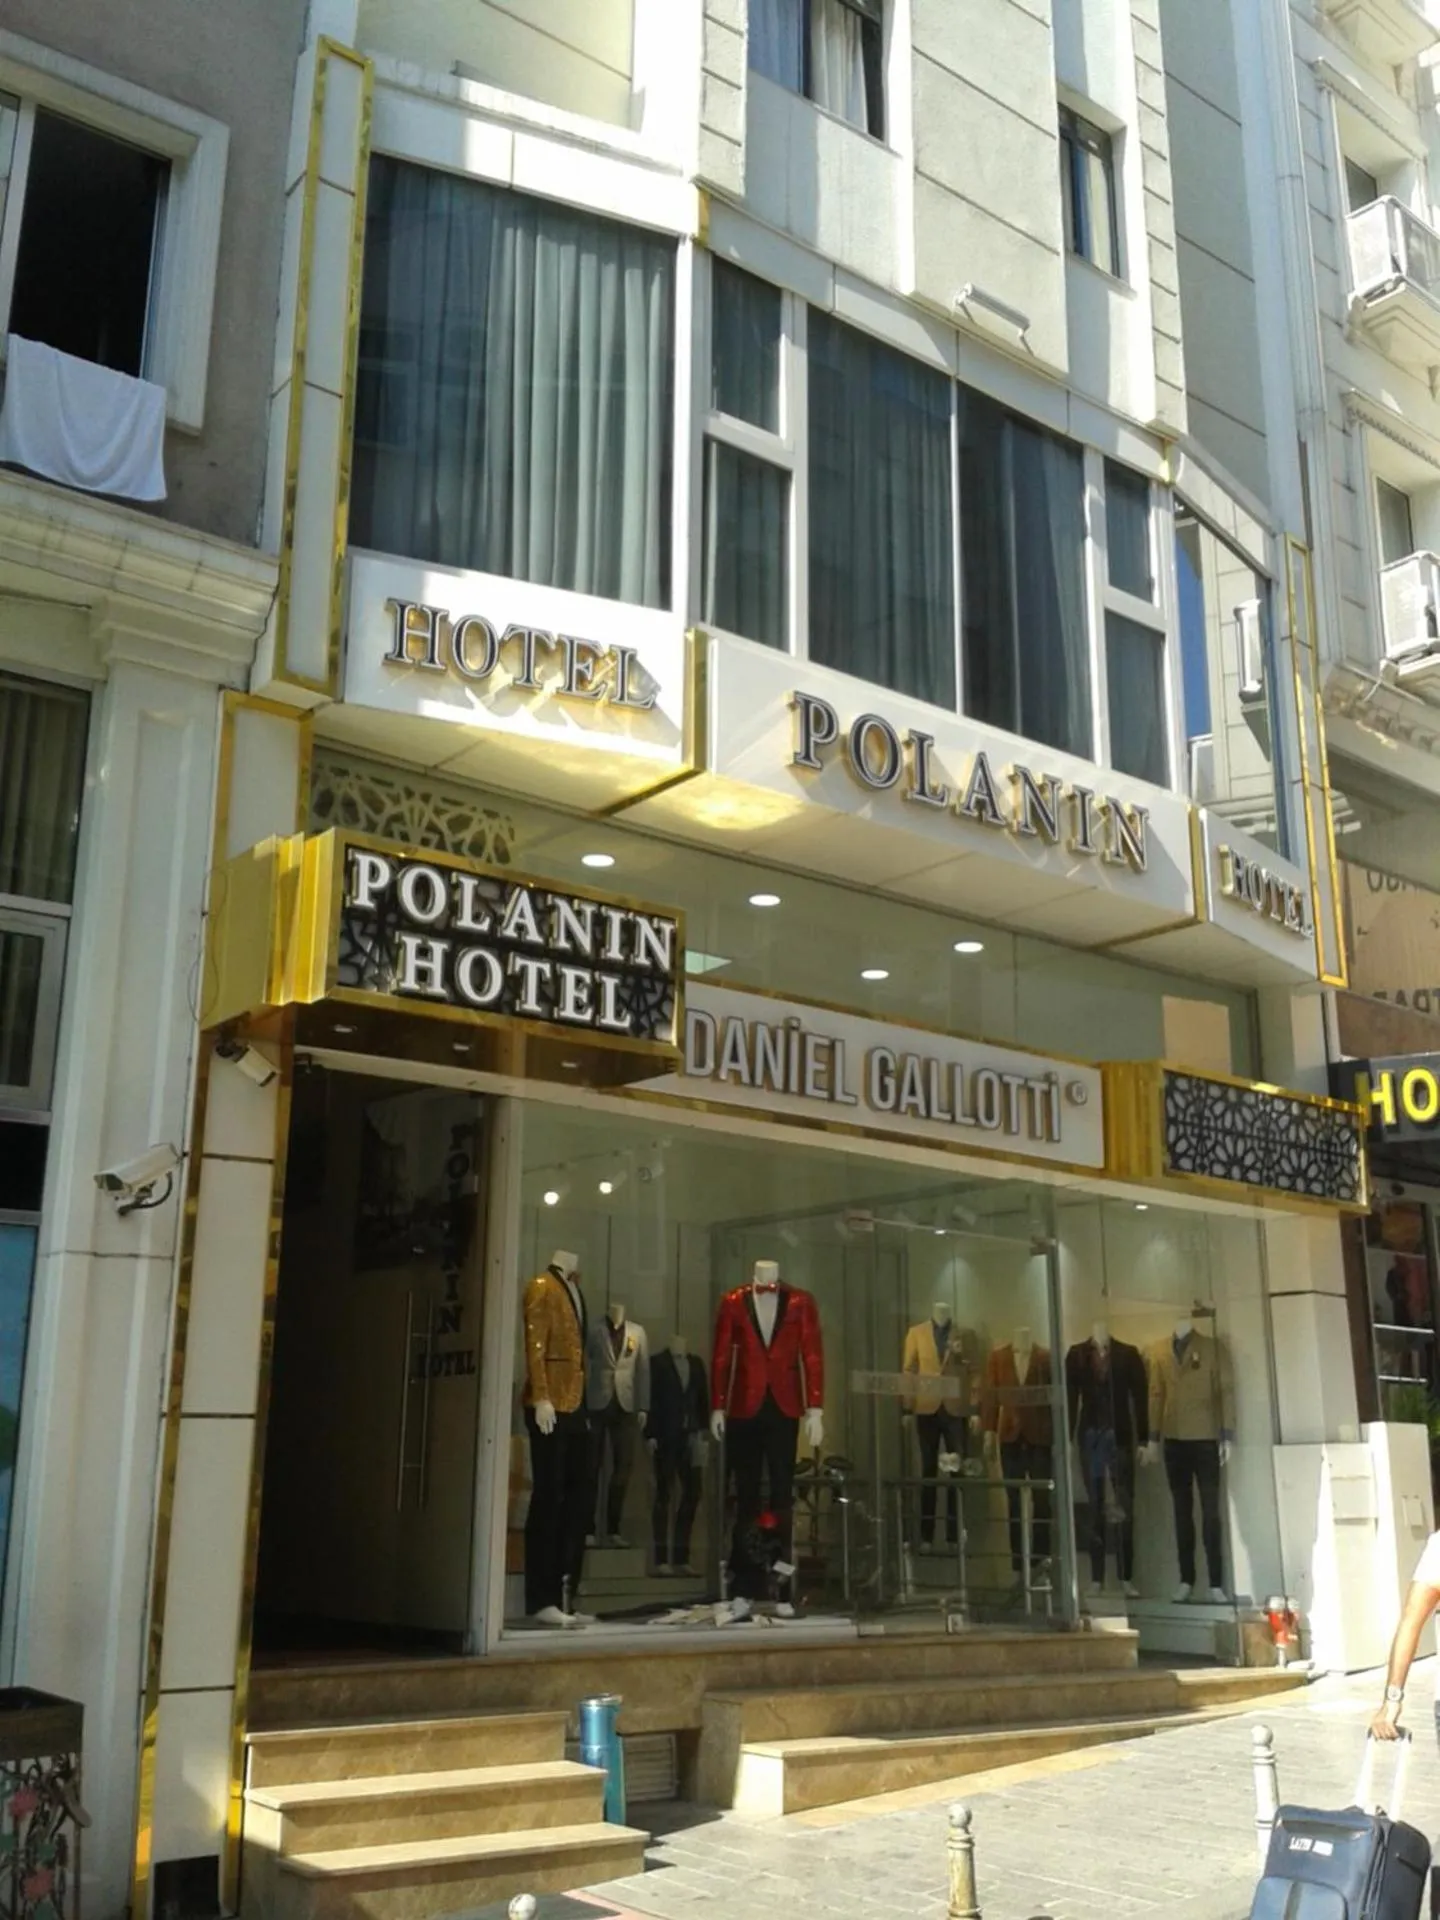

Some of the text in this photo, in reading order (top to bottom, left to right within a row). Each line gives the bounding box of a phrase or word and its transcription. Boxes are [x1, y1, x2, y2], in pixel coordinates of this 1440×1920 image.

[382, 597, 661, 710] HOTEL
[786, 689, 1149, 873] POLANIN
[345, 848, 676, 972] POLANIN
[1218, 844, 1314, 939] HOTEL
[396, 931, 631, 1028] HOTEL
